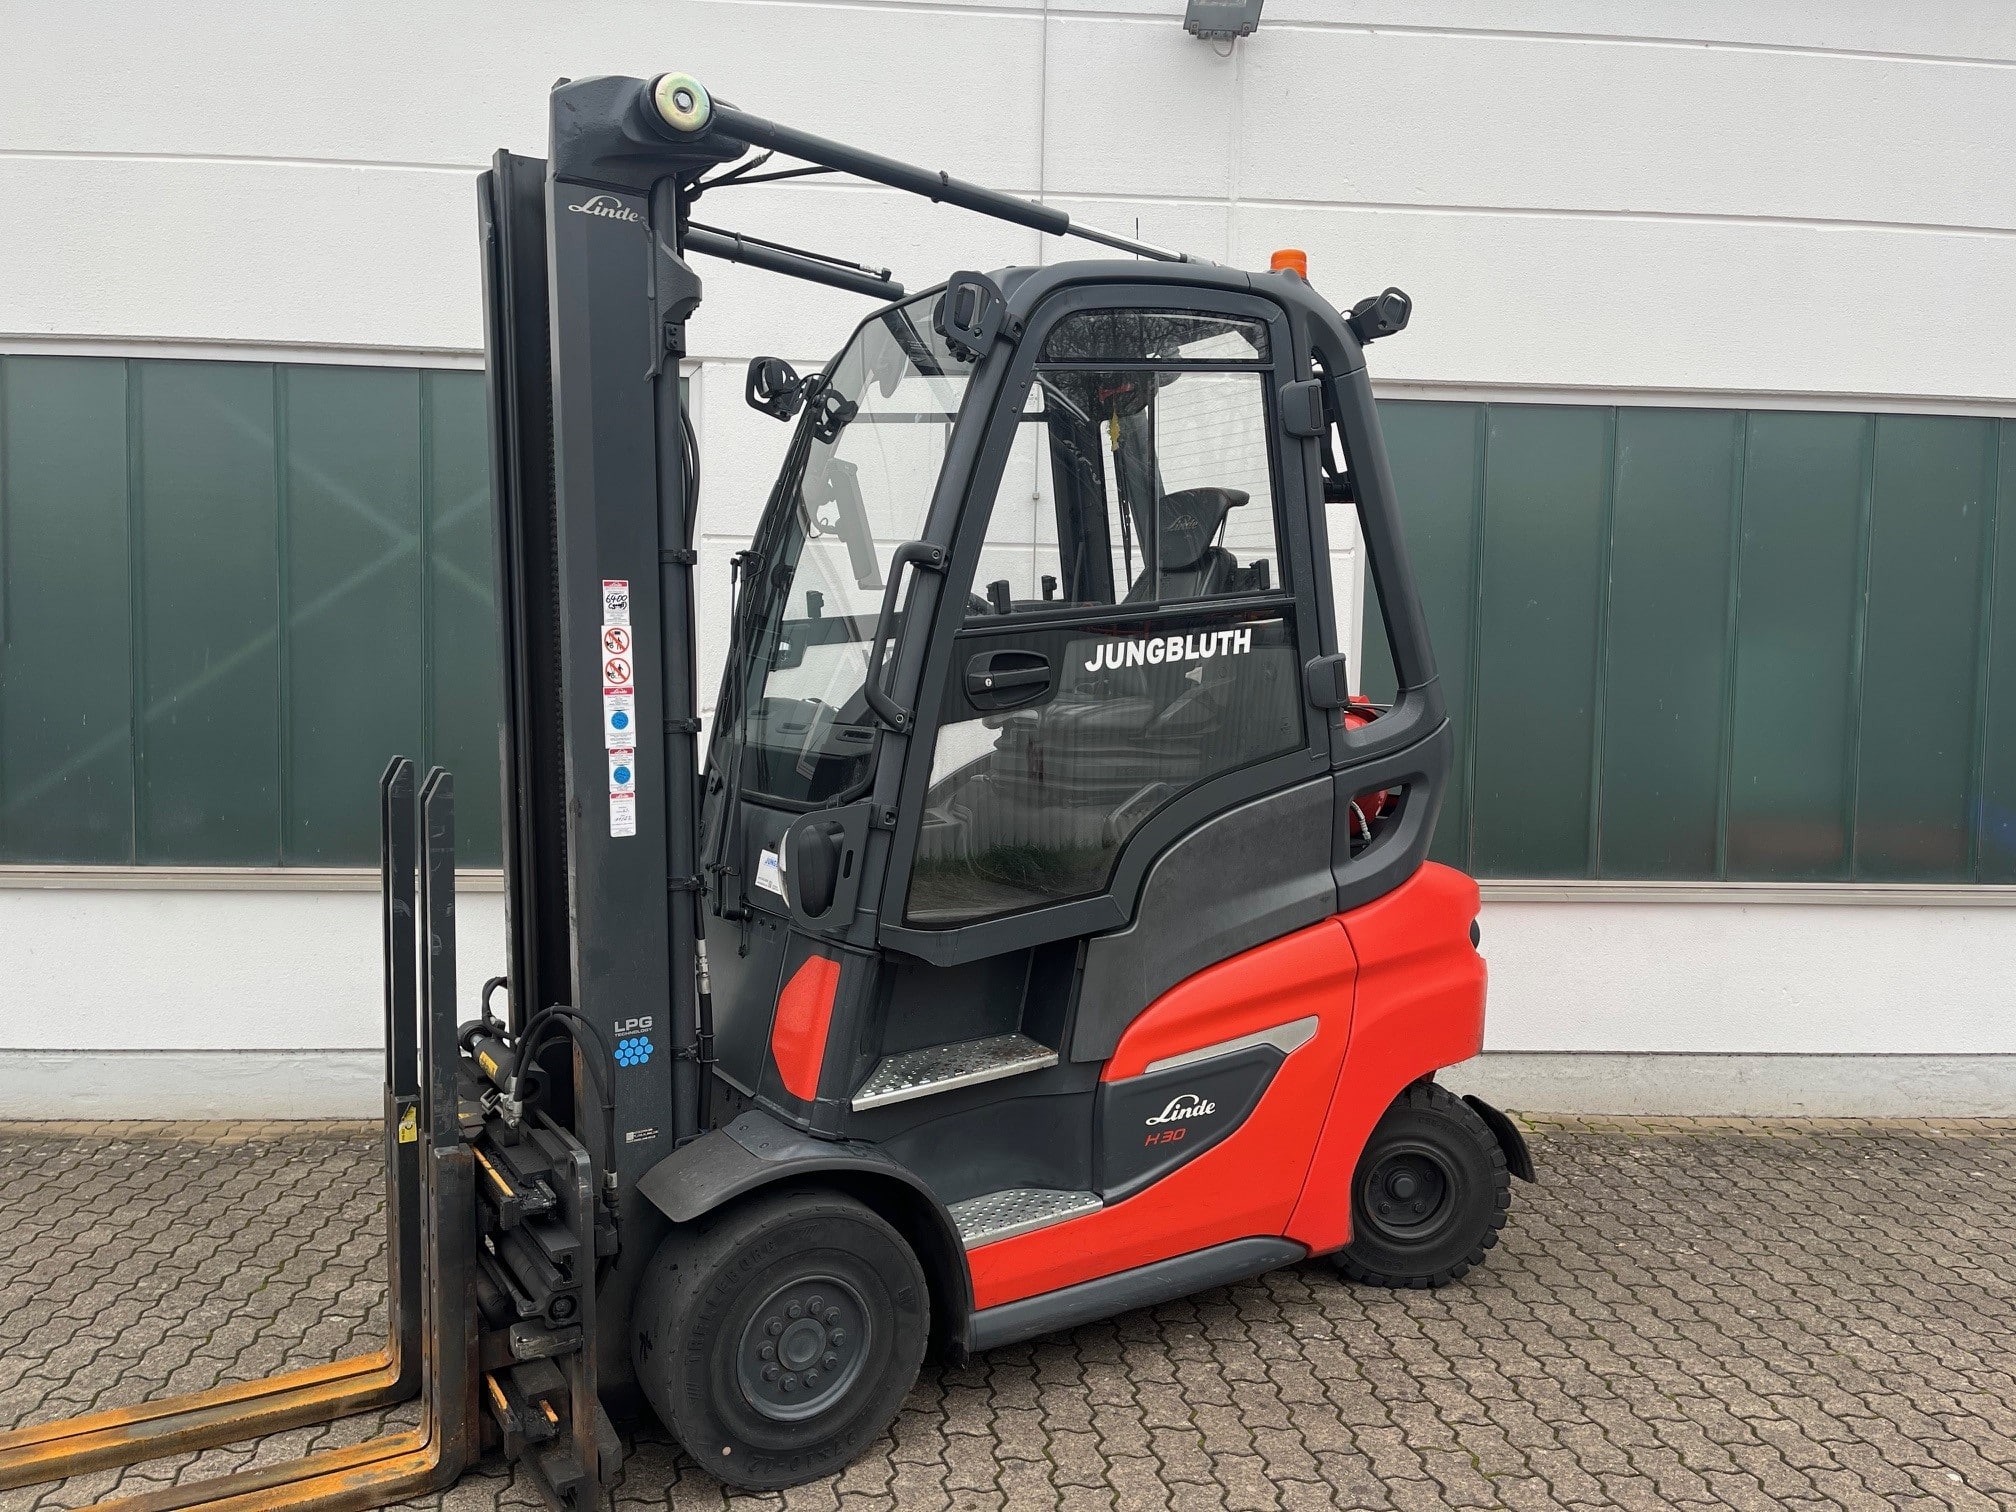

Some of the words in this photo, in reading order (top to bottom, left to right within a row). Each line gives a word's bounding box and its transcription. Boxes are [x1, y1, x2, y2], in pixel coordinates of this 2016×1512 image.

[568, 195, 639, 222] Linde
[1084, 628, 1252, 672] JUNGBLUTH
[614, 1016, 653, 1032] LPG
[614, 1027, 653, 1038] TECHNOLOGY
[1145, 1094, 1216, 1126] Linde
